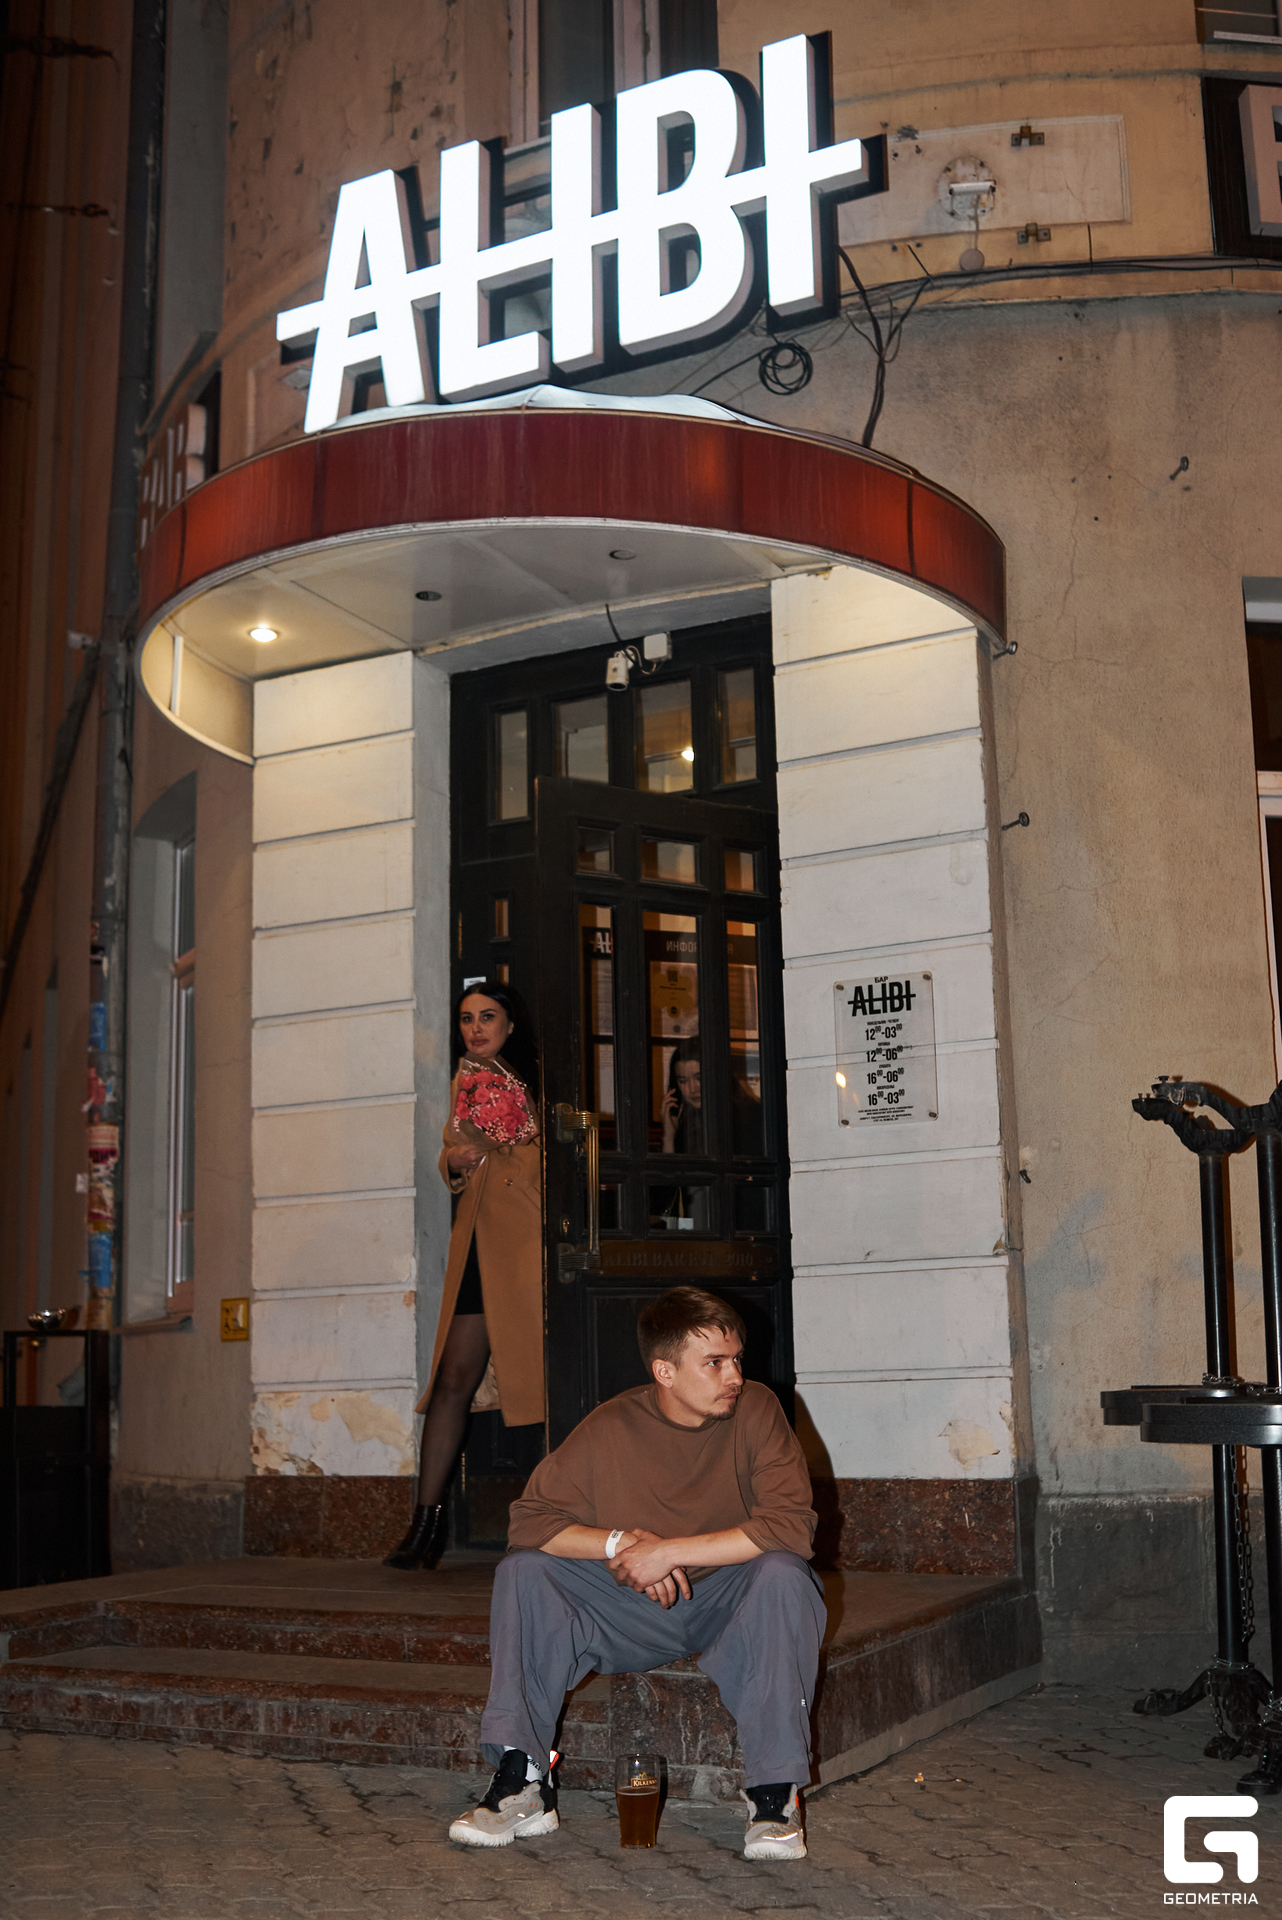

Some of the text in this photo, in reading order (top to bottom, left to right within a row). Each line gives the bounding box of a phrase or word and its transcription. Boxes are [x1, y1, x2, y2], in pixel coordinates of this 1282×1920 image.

[277, 34, 862, 434] ALIBI
[848, 980, 916, 1016] ALIBI
[604, 1252, 647, 1267] ALIBI
[652, 1252, 685, 1267] BAR
[726, 1252, 753, 1267] 2010
